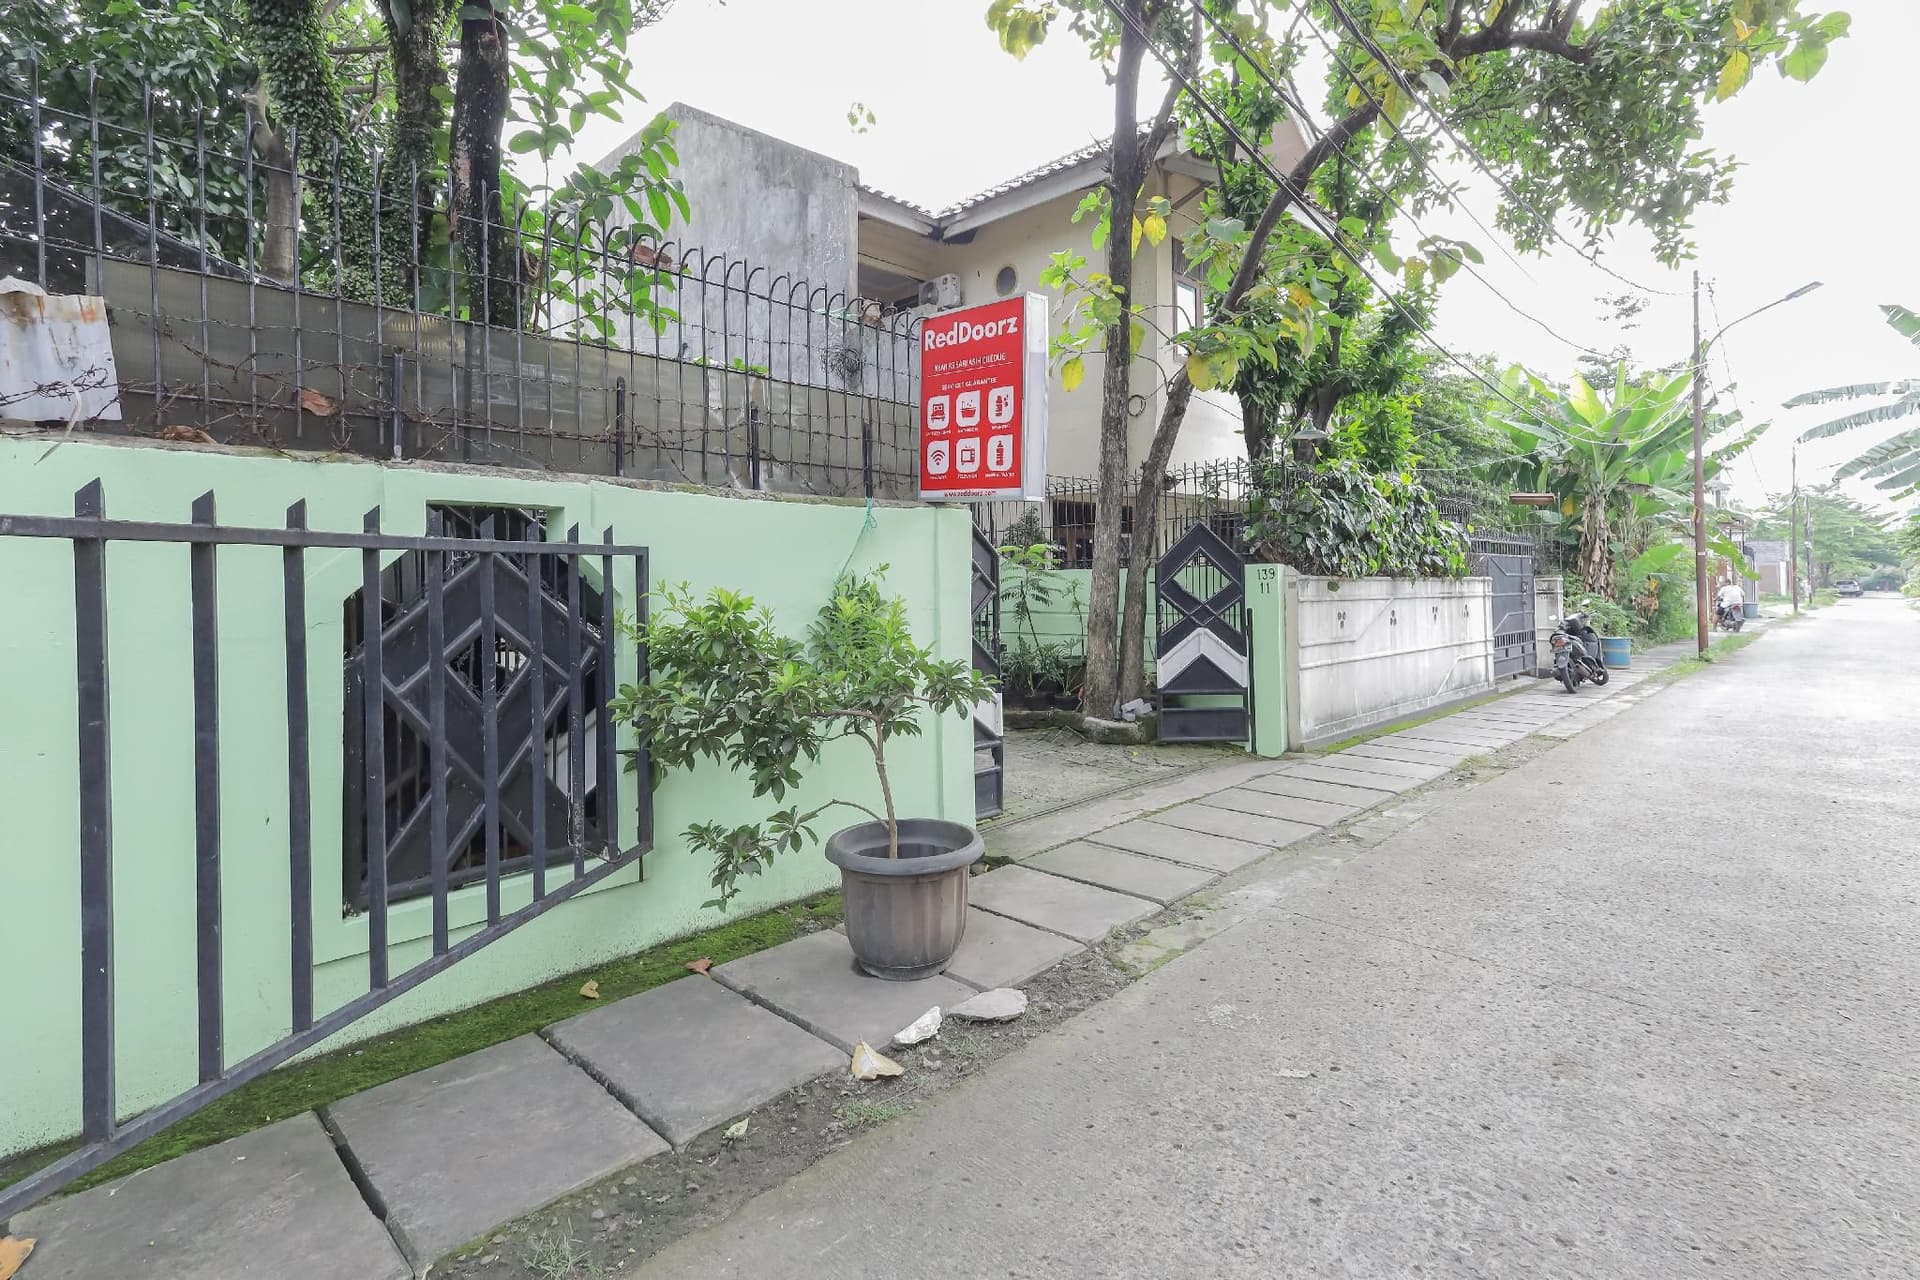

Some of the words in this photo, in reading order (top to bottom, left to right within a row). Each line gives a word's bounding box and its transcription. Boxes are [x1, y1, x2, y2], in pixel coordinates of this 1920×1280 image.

[924, 316, 1018, 352] RedDoorz
[982, 352, 1006, 365] CILEDUG
[1257, 568, 1275, 580] 139
[1260, 582, 1270, 594] 11
